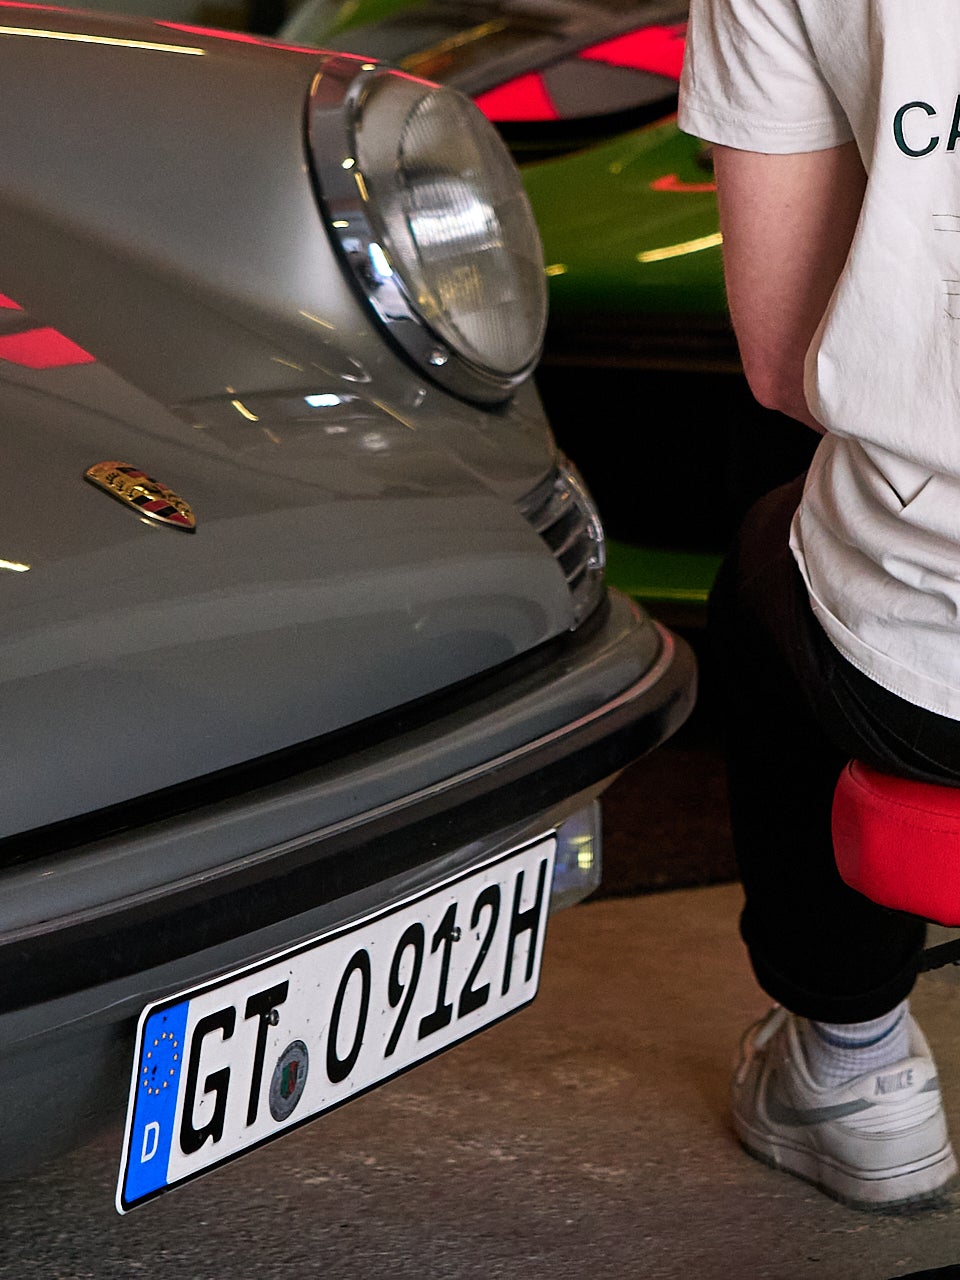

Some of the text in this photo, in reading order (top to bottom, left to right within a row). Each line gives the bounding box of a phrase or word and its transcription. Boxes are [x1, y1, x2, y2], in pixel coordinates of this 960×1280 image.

[179, 980, 289, 1155] GT
[874, 1068, 912, 1095] NIKE
[140, 1121, 160, 1164] D
